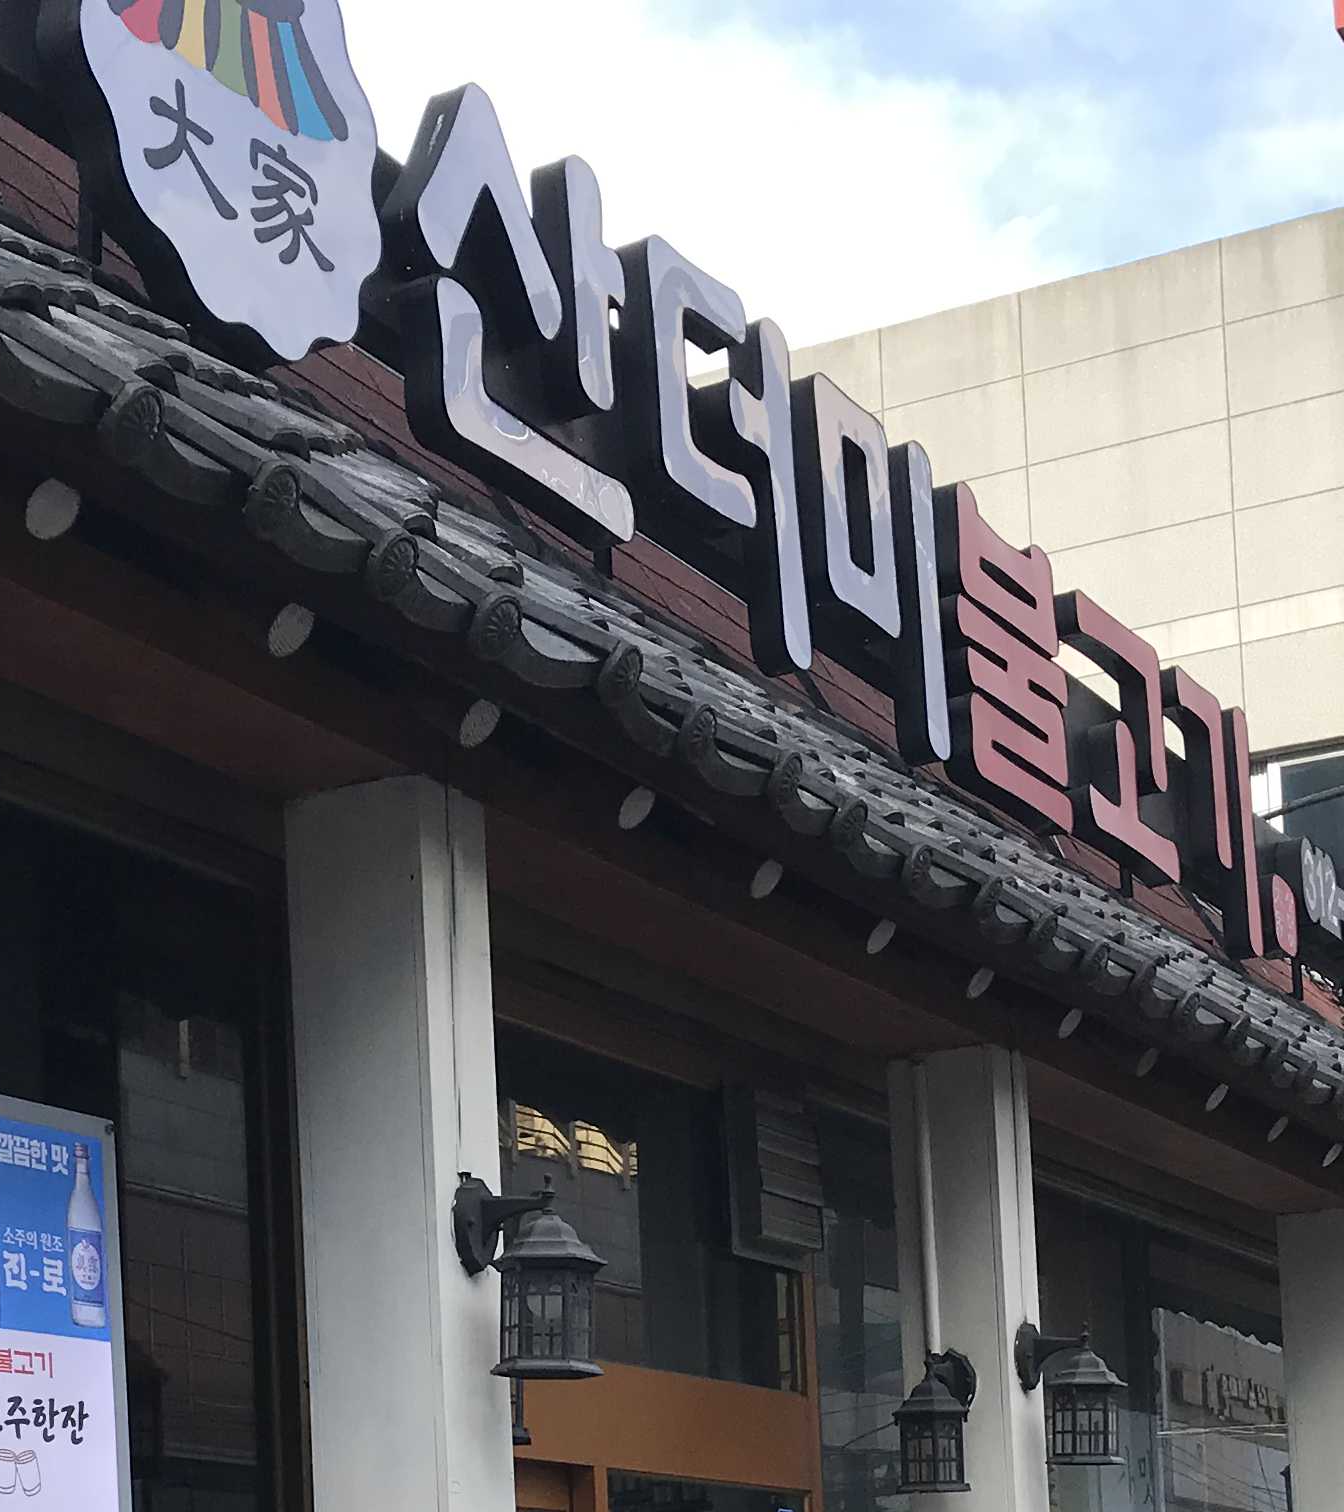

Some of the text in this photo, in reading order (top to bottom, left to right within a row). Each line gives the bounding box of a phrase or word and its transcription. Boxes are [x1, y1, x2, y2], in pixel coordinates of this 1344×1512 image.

[142, 78, 335, 272] 大家
[50, 1142, 70, 1176] 맛
[2, 1226, 65, 1253] 소주의 원조
